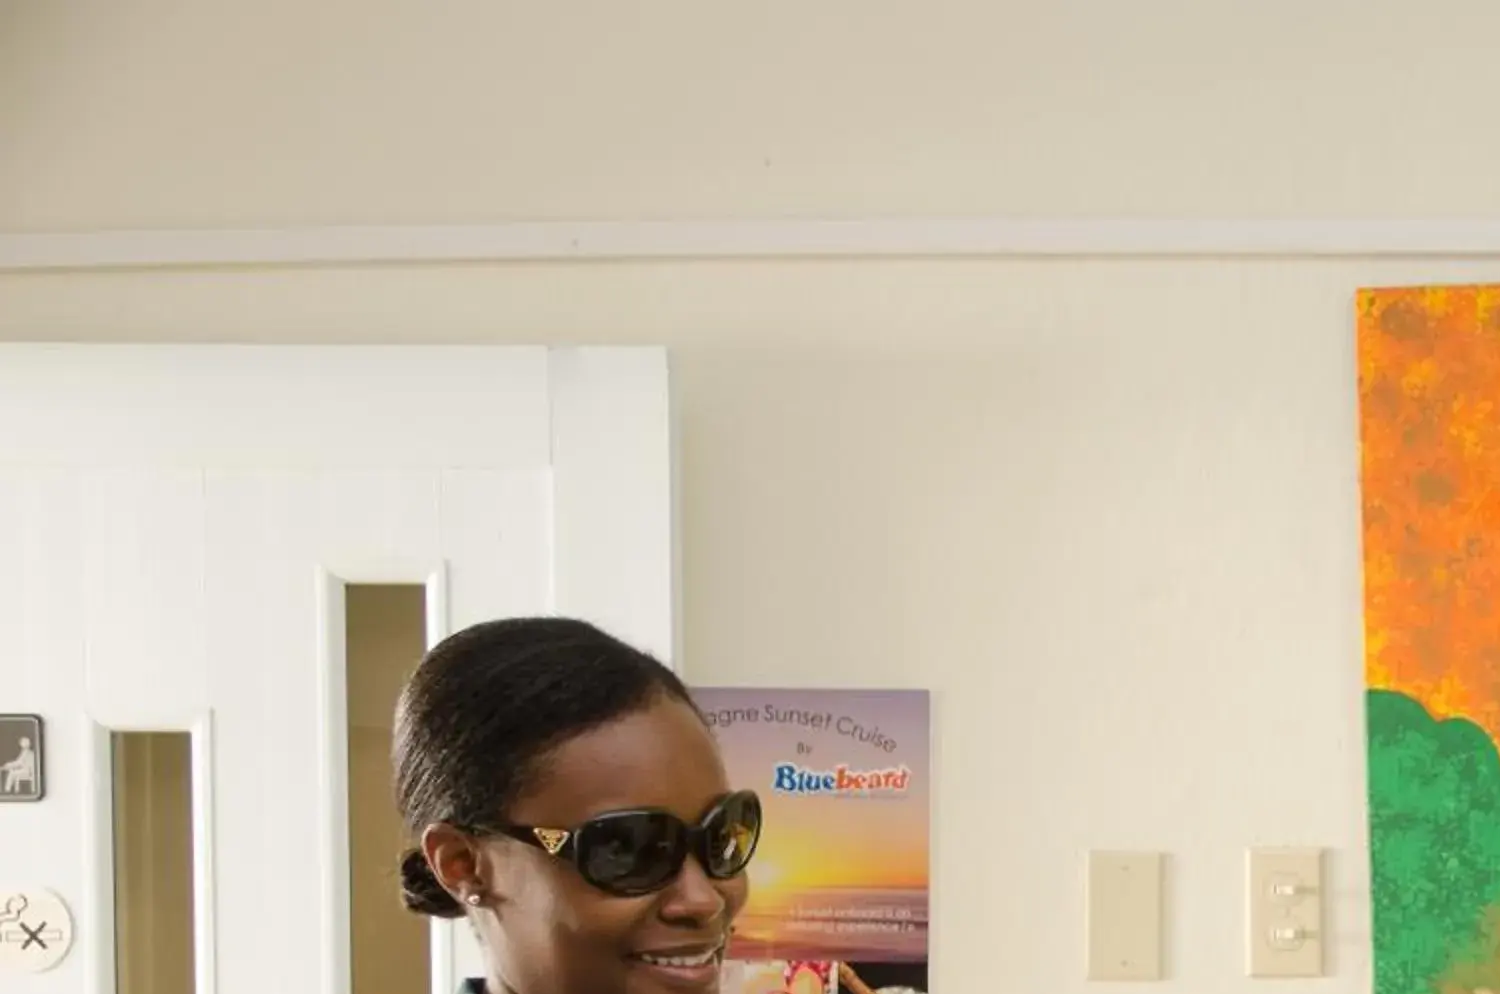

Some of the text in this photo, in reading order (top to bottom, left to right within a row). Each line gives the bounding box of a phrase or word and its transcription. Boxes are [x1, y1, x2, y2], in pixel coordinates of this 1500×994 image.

[703, 704, 898, 754] agne Sunset Cruise
[773, 763, 910, 792] Bluebeard
